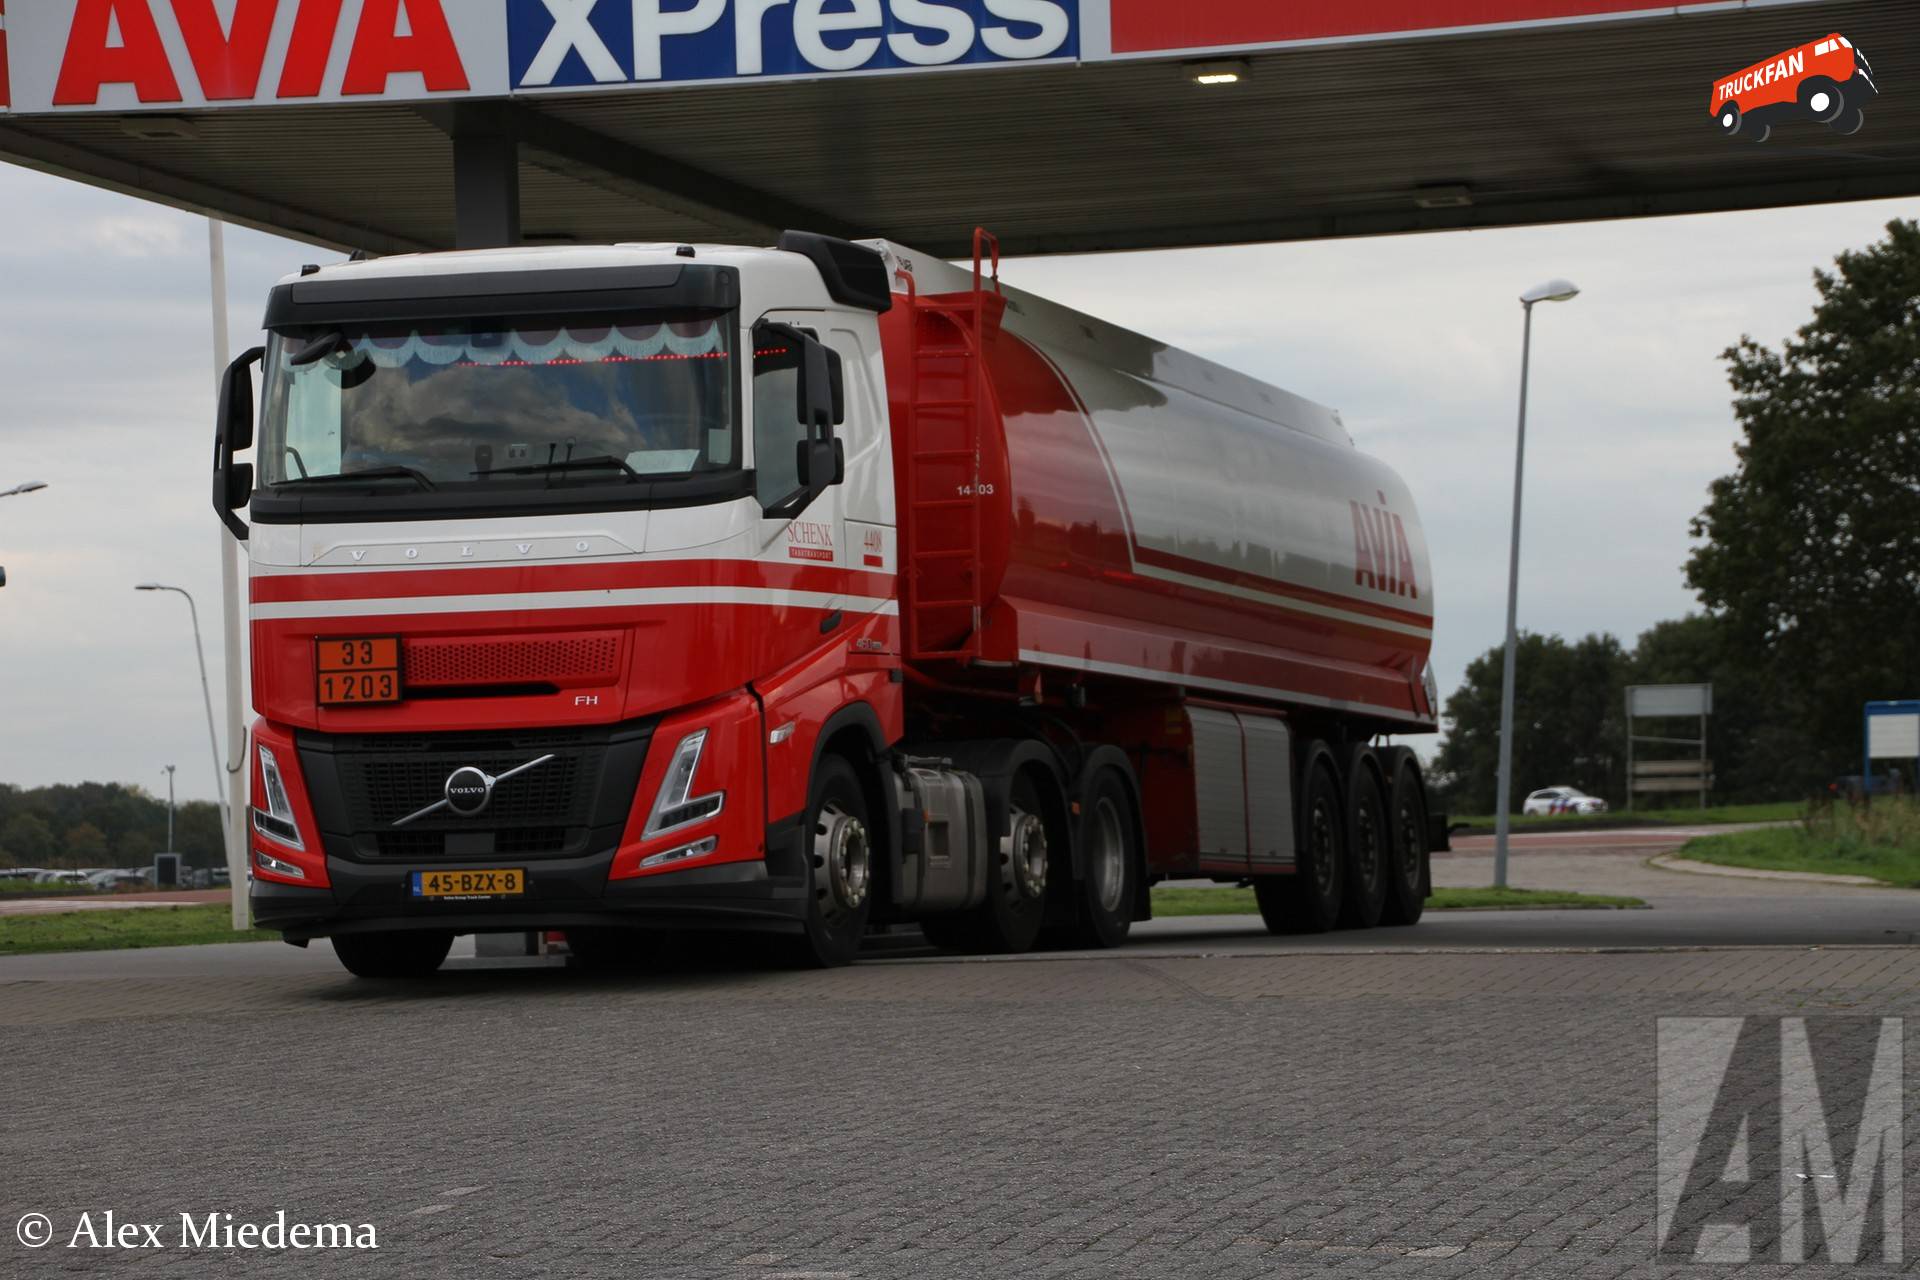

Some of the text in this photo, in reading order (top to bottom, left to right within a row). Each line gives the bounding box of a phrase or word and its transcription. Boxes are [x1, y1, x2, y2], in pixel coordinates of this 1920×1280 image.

[52, 0, 471, 105] AVIA
[787, 520, 833, 546] SCHENK
[351, 540, 590, 561] VOLVO
[342, 640, 373, 665] 33
[324, 674, 392, 700] 1203
[574, 695, 598, 706] FH
[428, 873, 516, 892] 45-BZX-8
